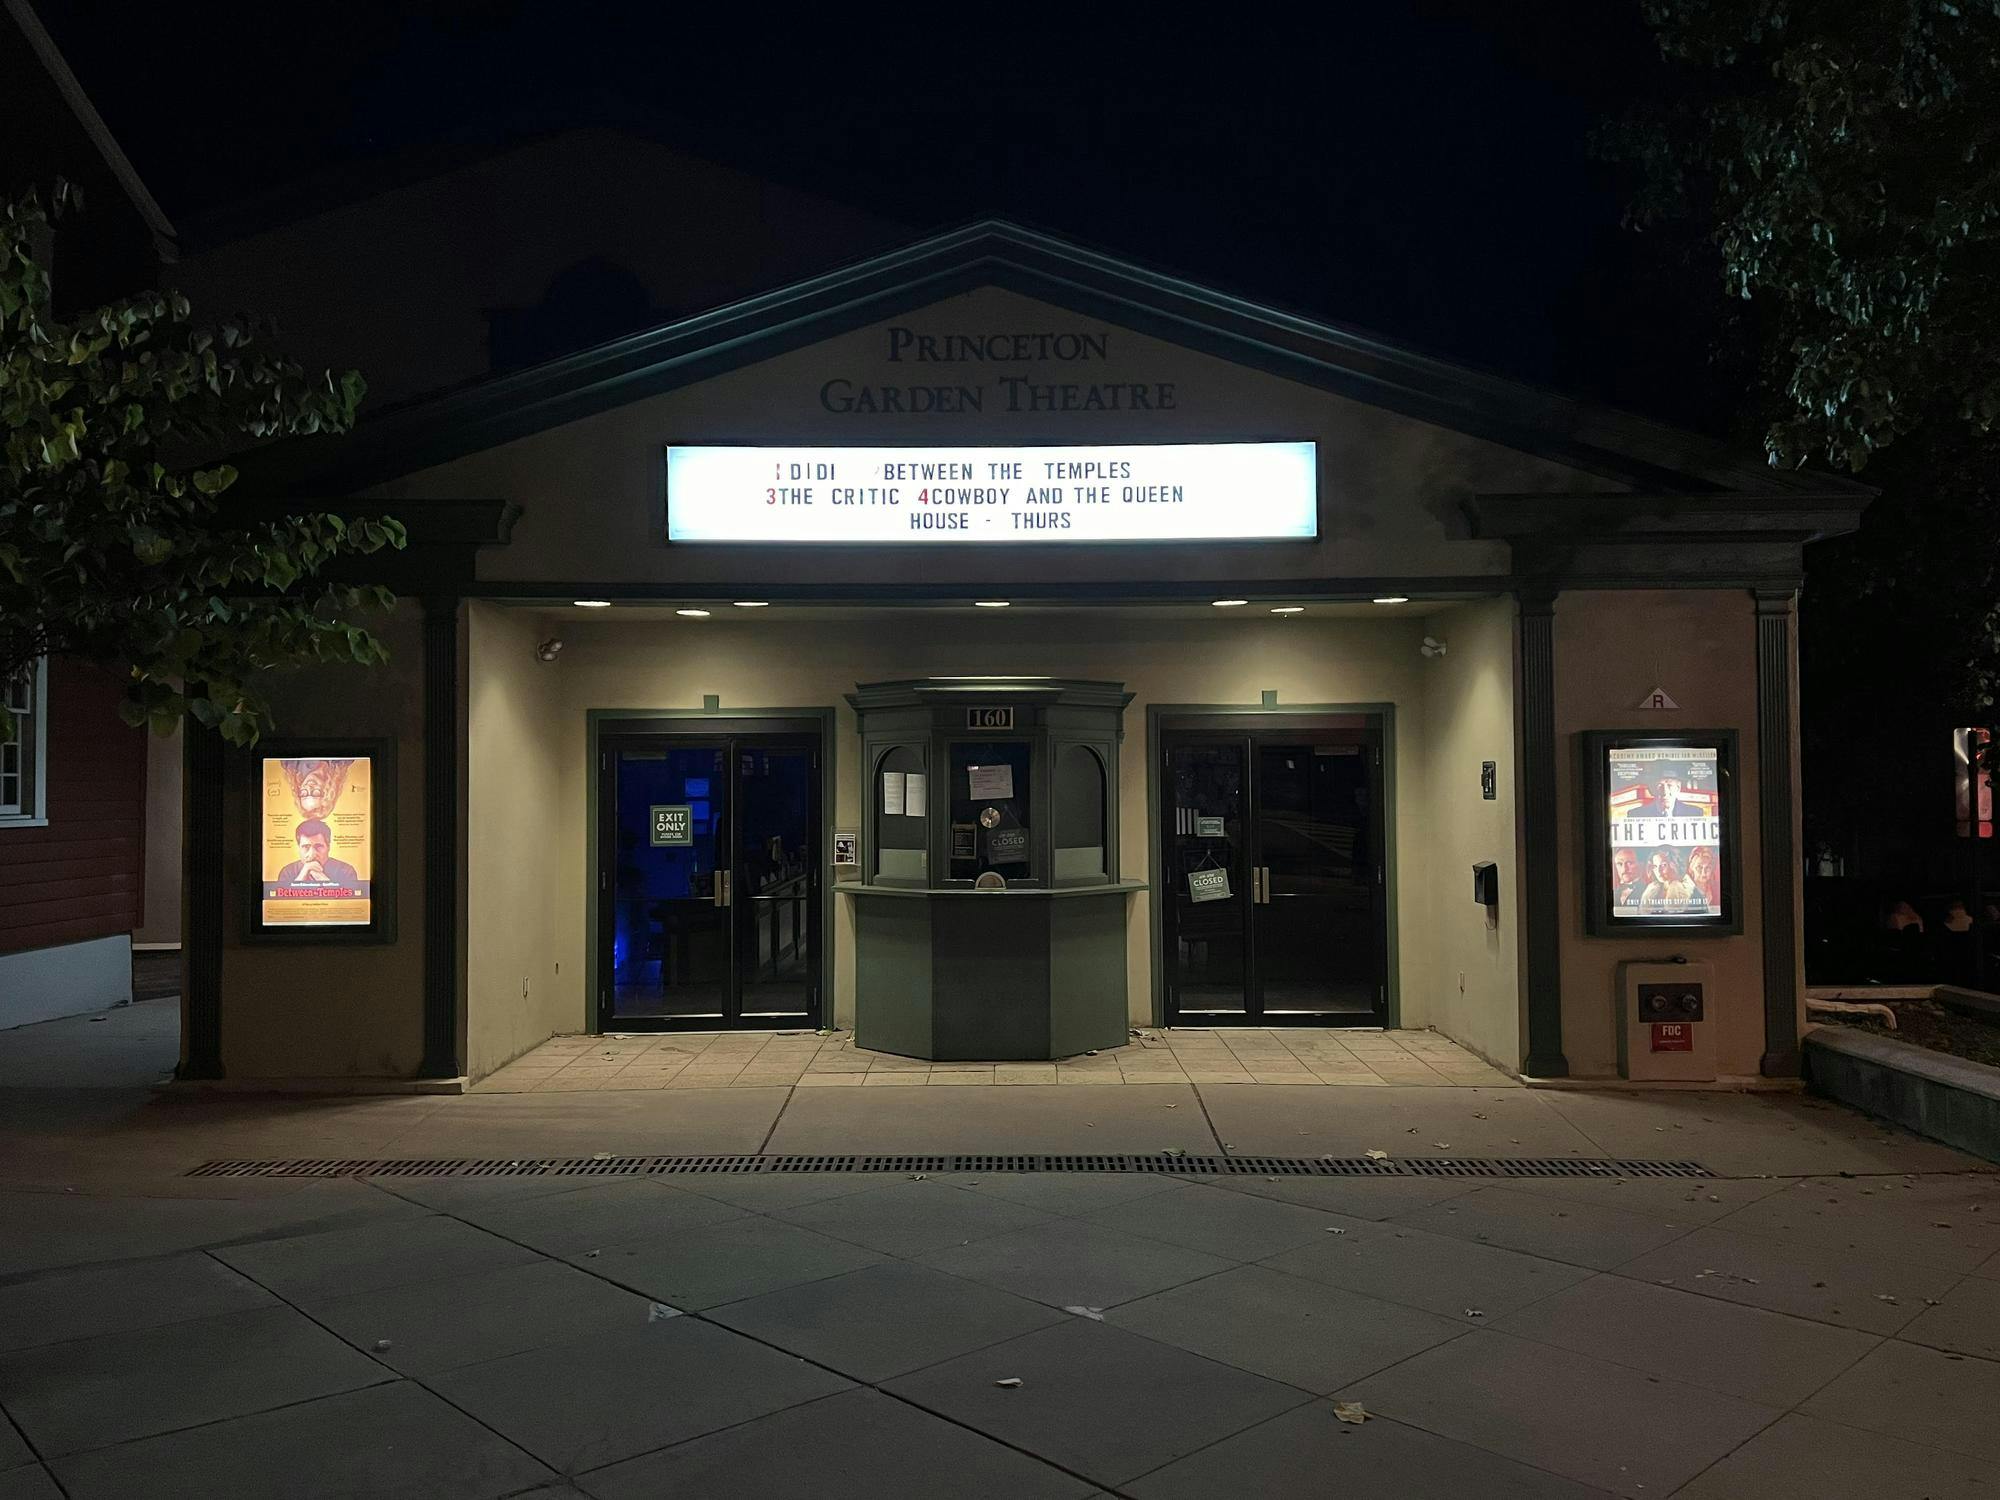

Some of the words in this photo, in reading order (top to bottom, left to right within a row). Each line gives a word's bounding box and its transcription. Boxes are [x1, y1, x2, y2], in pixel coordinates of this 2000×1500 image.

[888, 328, 1110, 361] PRINCETON
[820, 379, 983, 413] GARDEN
[999, 376, 1176, 412] THEATRE
[884, 463, 973, 480] BETWEEN
[988, 463, 1022, 480] THE
[1044, 462, 1130, 479] TEMPLES
[832, 488, 900, 505] CRITIC
[1026, 487, 1063, 504] AND
[1074, 487, 1110, 503] THE
[1122, 486, 1183, 503] QUEEN
[910, 513, 969, 530] HOUSE
[1011, 512, 1071, 529] THURS
[1653, 694, 1664, 709] R
[973, 709, 1007, 726] 160
[658, 813, 684, 822] EXIT
[656, 822, 686, 832] ONLY
[1611, 823, 1644, 841] THE
[1658, 822, 1718, 841] CRITIC
[991, 836, 1025, 847] CLOSED
[1193, 876, 1223, 887] CLOSED
[277, 887, 313, 897] Between
[316, 887, 353, 898] Temples
[1662, 1025, 1681, 1036] FDC
